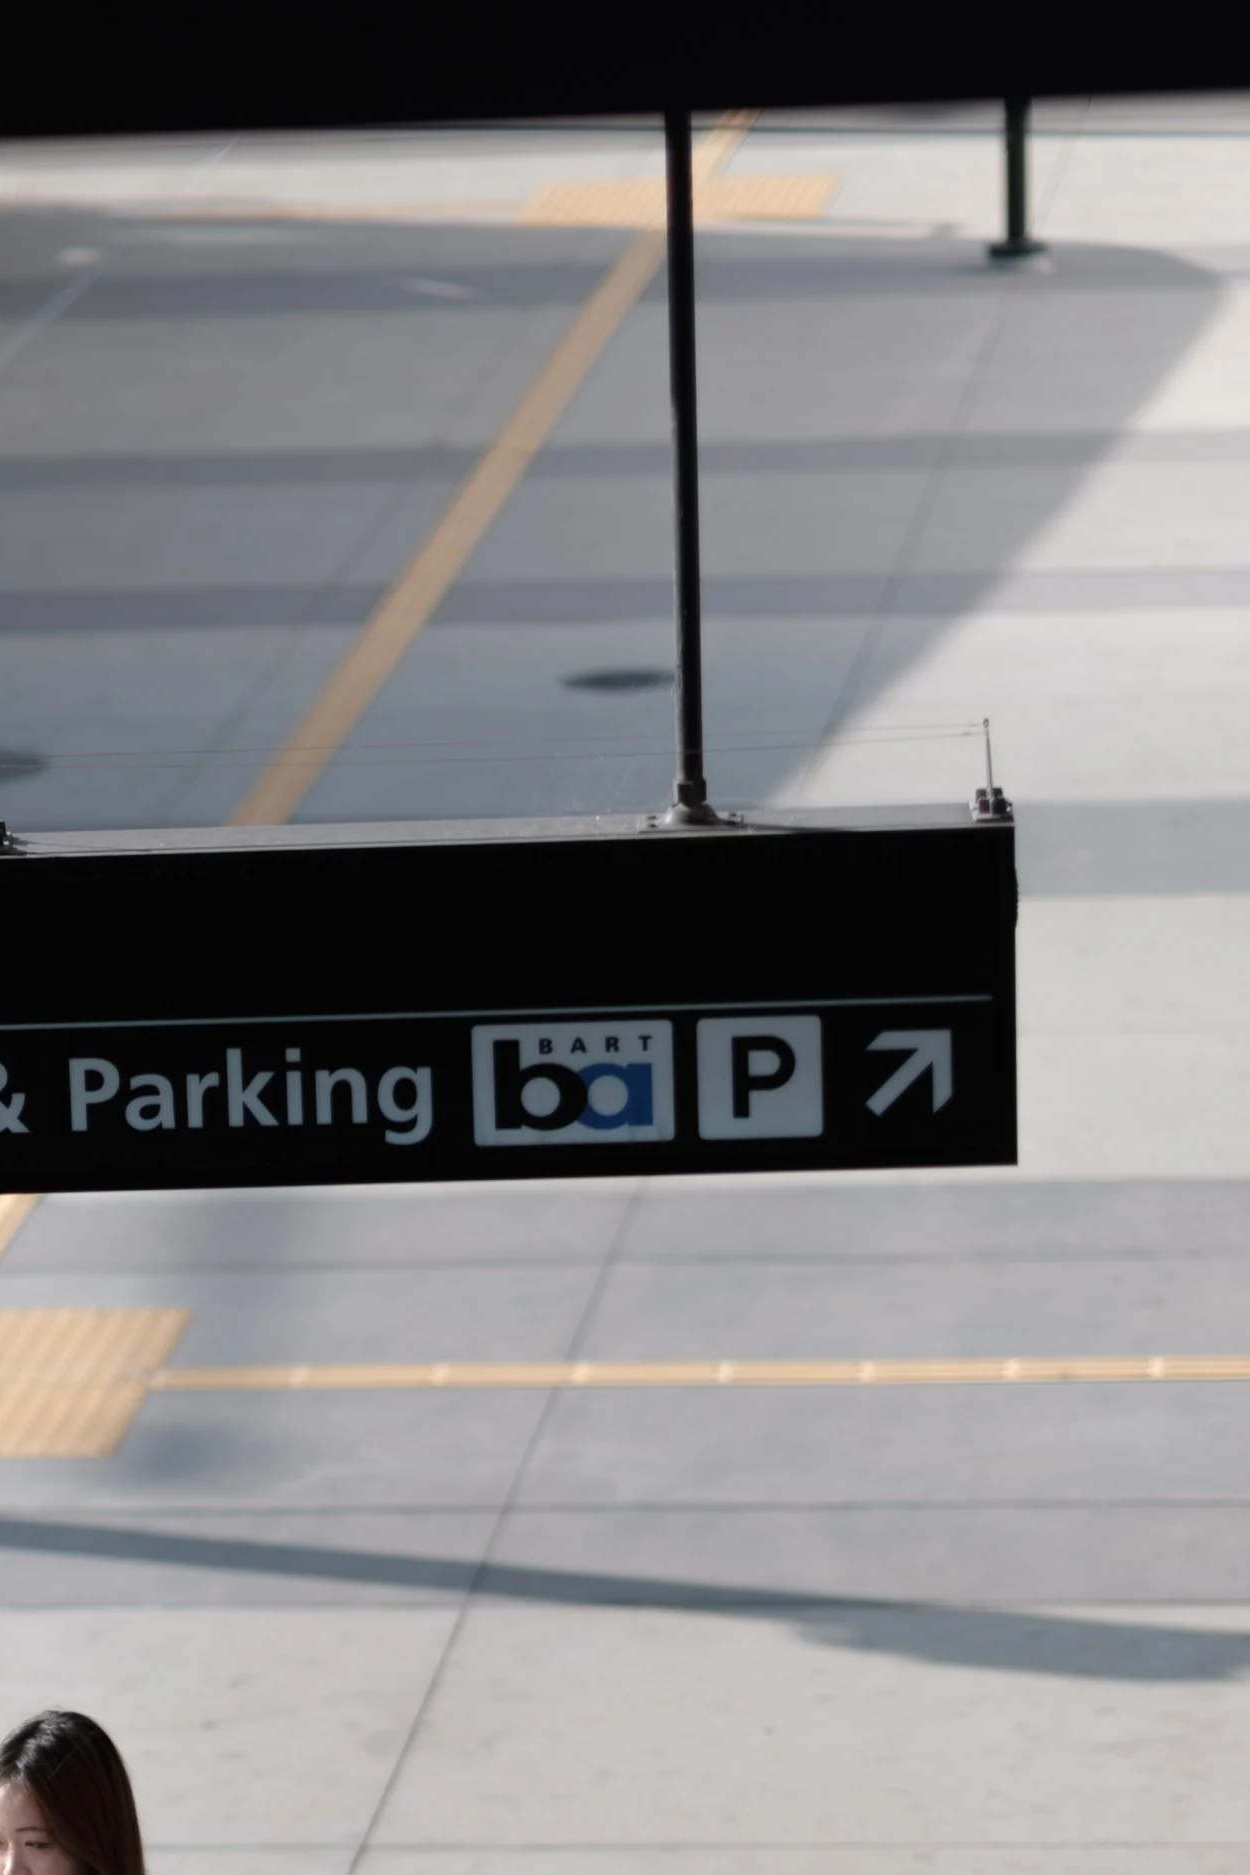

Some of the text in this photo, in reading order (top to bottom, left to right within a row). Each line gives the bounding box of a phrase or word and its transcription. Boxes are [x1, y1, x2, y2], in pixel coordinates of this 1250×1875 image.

[538, 1035, 654, 1055] BART
[731, 1034, 796, 1120] P
[69, 1047, 432, 1145] Parking
